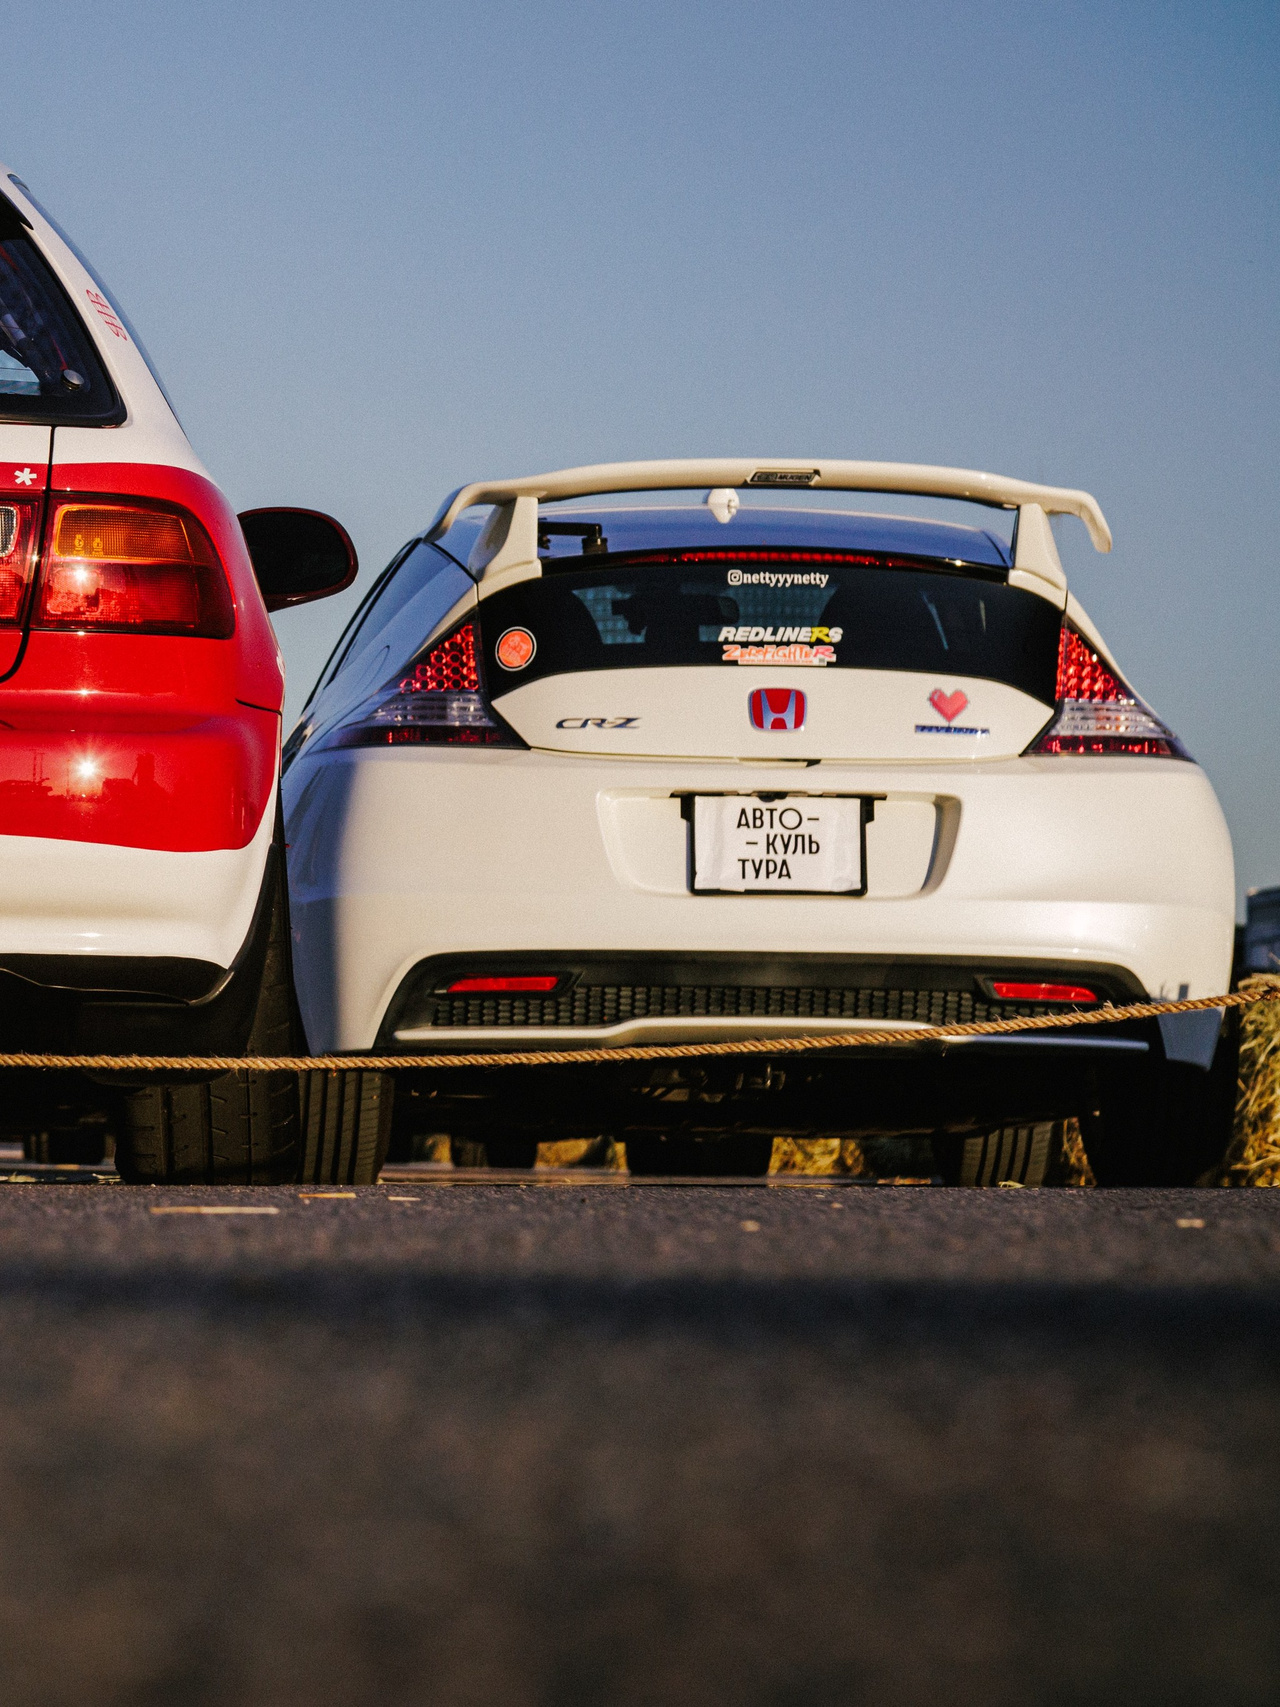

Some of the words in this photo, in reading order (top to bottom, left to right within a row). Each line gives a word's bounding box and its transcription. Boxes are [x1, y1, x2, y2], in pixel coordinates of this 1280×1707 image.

[718, 626, 844, 643] REDLINERS
[555, 717, 641, 729] CR-Z
[738, 858, 792, 879] ТУРА
